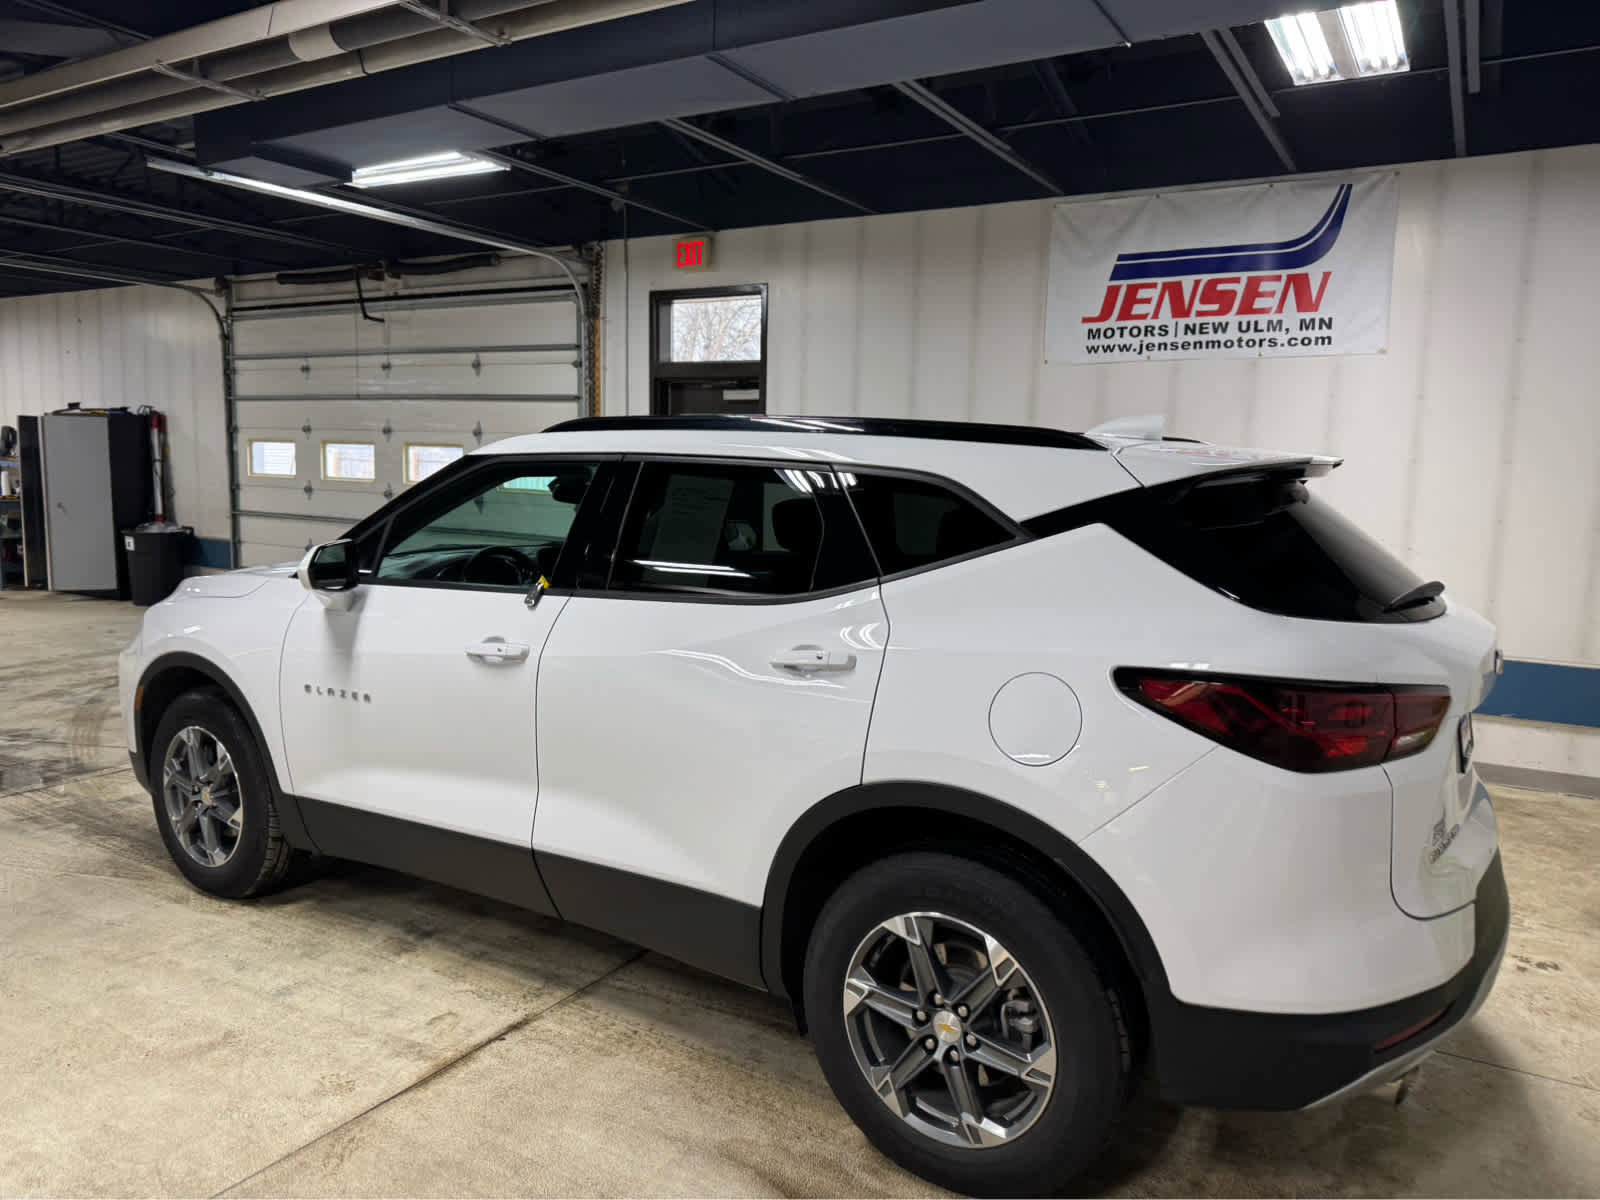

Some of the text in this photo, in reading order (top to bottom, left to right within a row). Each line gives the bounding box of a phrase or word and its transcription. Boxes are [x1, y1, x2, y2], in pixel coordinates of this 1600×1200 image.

[676, 241, 704, 267] EXIT
[1081, 271, 1332, 324] JENSEN
[1087, 316, 1333, 340] MOTORS NEW ULM, MN
[1086, 335, 1333, 355] www.jensenmotors.com
